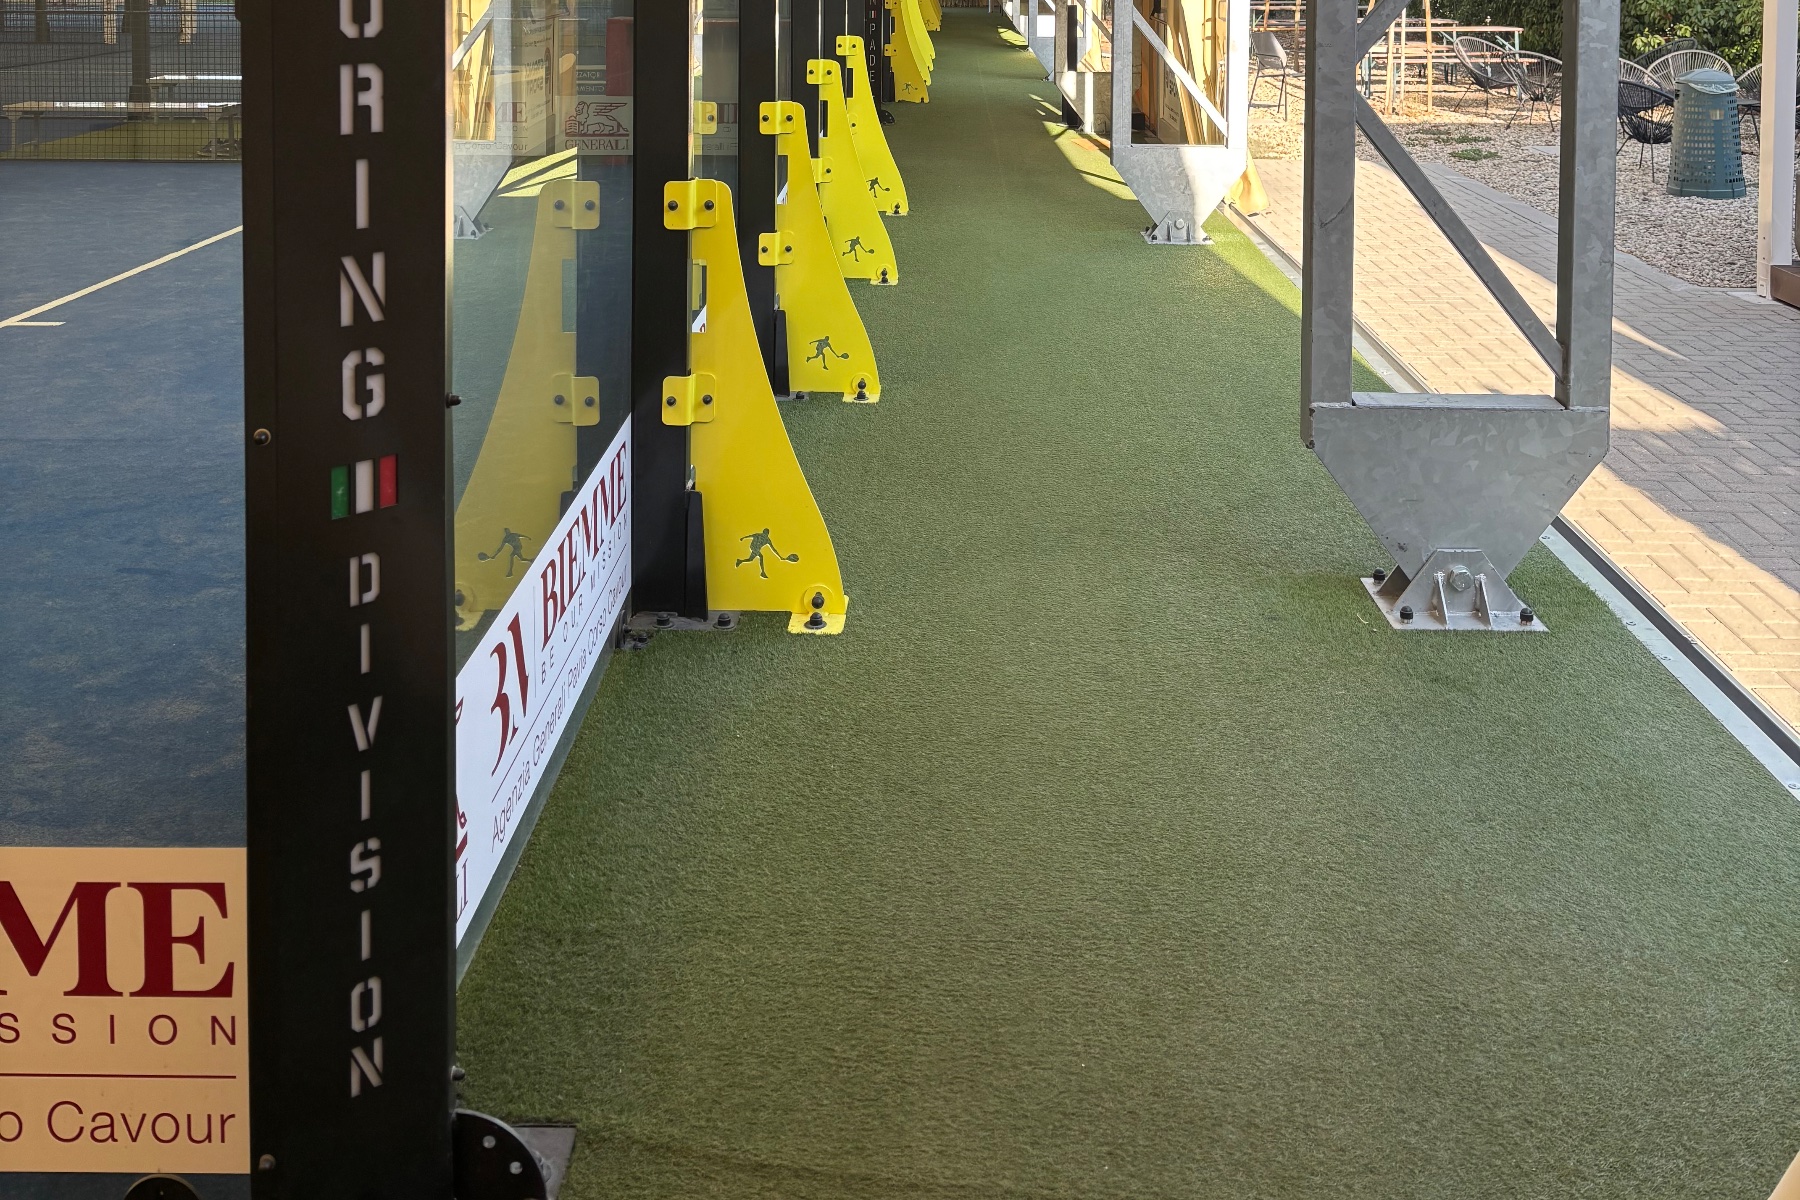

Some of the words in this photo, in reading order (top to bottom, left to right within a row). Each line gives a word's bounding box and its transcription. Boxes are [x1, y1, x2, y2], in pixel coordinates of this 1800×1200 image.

[868, 22, 877, 96] PADE
[564, 139, 629, 151] GENERALI
[540, 441, 627, 652] BIEMME
[590, 510, 628, 593] MISSION
[491, 761, 531, 853] Agenzia
[533, 682, 566, 766] Generali
[567, 648, 587, 698] Pavia
[588, 608, 607, 655] Corso
[607, 564, 628, 615] Cavour
[347, 551, 383, 1098] DIVISION
[47, 1100, 237, 1144] Cavour
